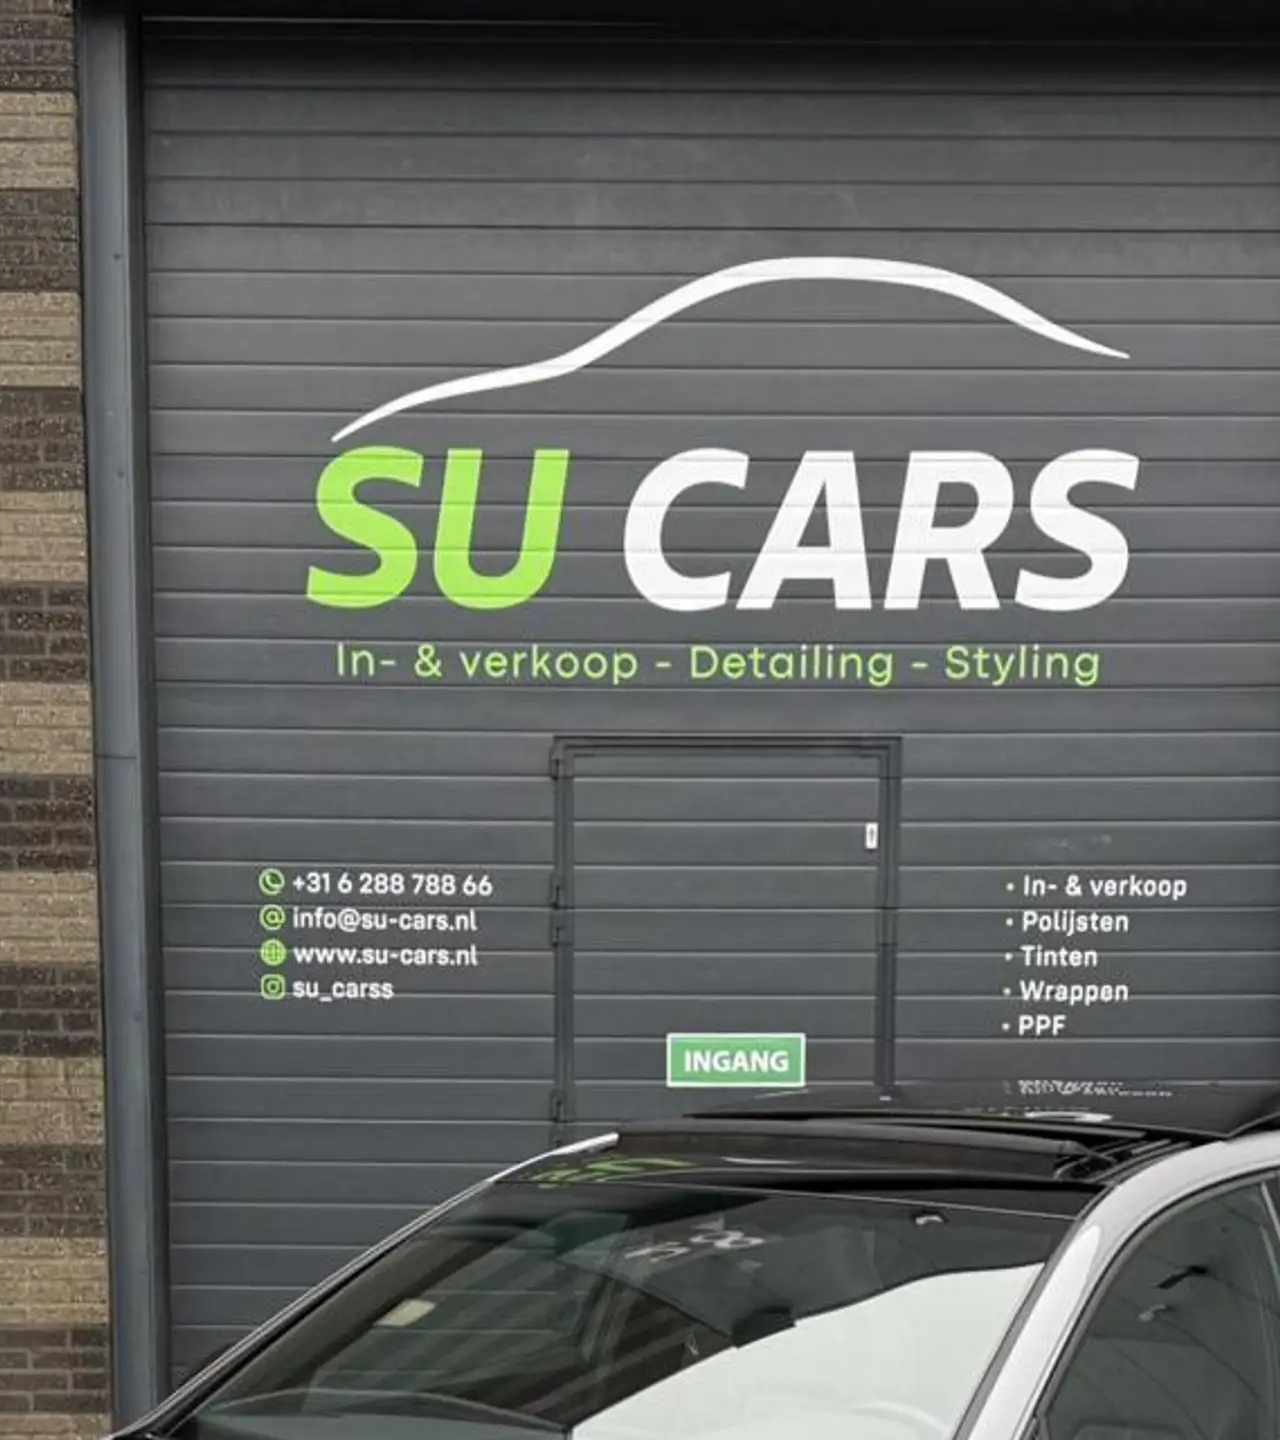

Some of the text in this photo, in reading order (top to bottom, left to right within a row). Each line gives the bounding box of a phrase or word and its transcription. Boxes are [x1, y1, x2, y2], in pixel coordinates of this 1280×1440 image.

[304, 444, 1141, 612] SU CARS
[335, 644, 397, 679] In-
[413, 643, 445, 680] &
[461, 646, 638, 684] verkoop
[690, 645, 895, 687] Detailing
[944, 645, 1101, 687] Styling
[292, 872, 494, 896] +31 6 288 788 66
[1023, 874, 1187, 901] In- & verkoop
[292, 908, 478, 933] info@su-cars.nl
[1022, 909, 1130, 937] Polijsten
[292, 944, 479, 967] www.su-cars.nl
[1020, 944, 1098, 967] Tinten
[292, 980, 395, 1002] su_carss
[1019, 980, 1129, 1006] Wrappen
[1018, 1014, 1067, 1036] PPF
[684, 1050, 789, 1073] INGANG
